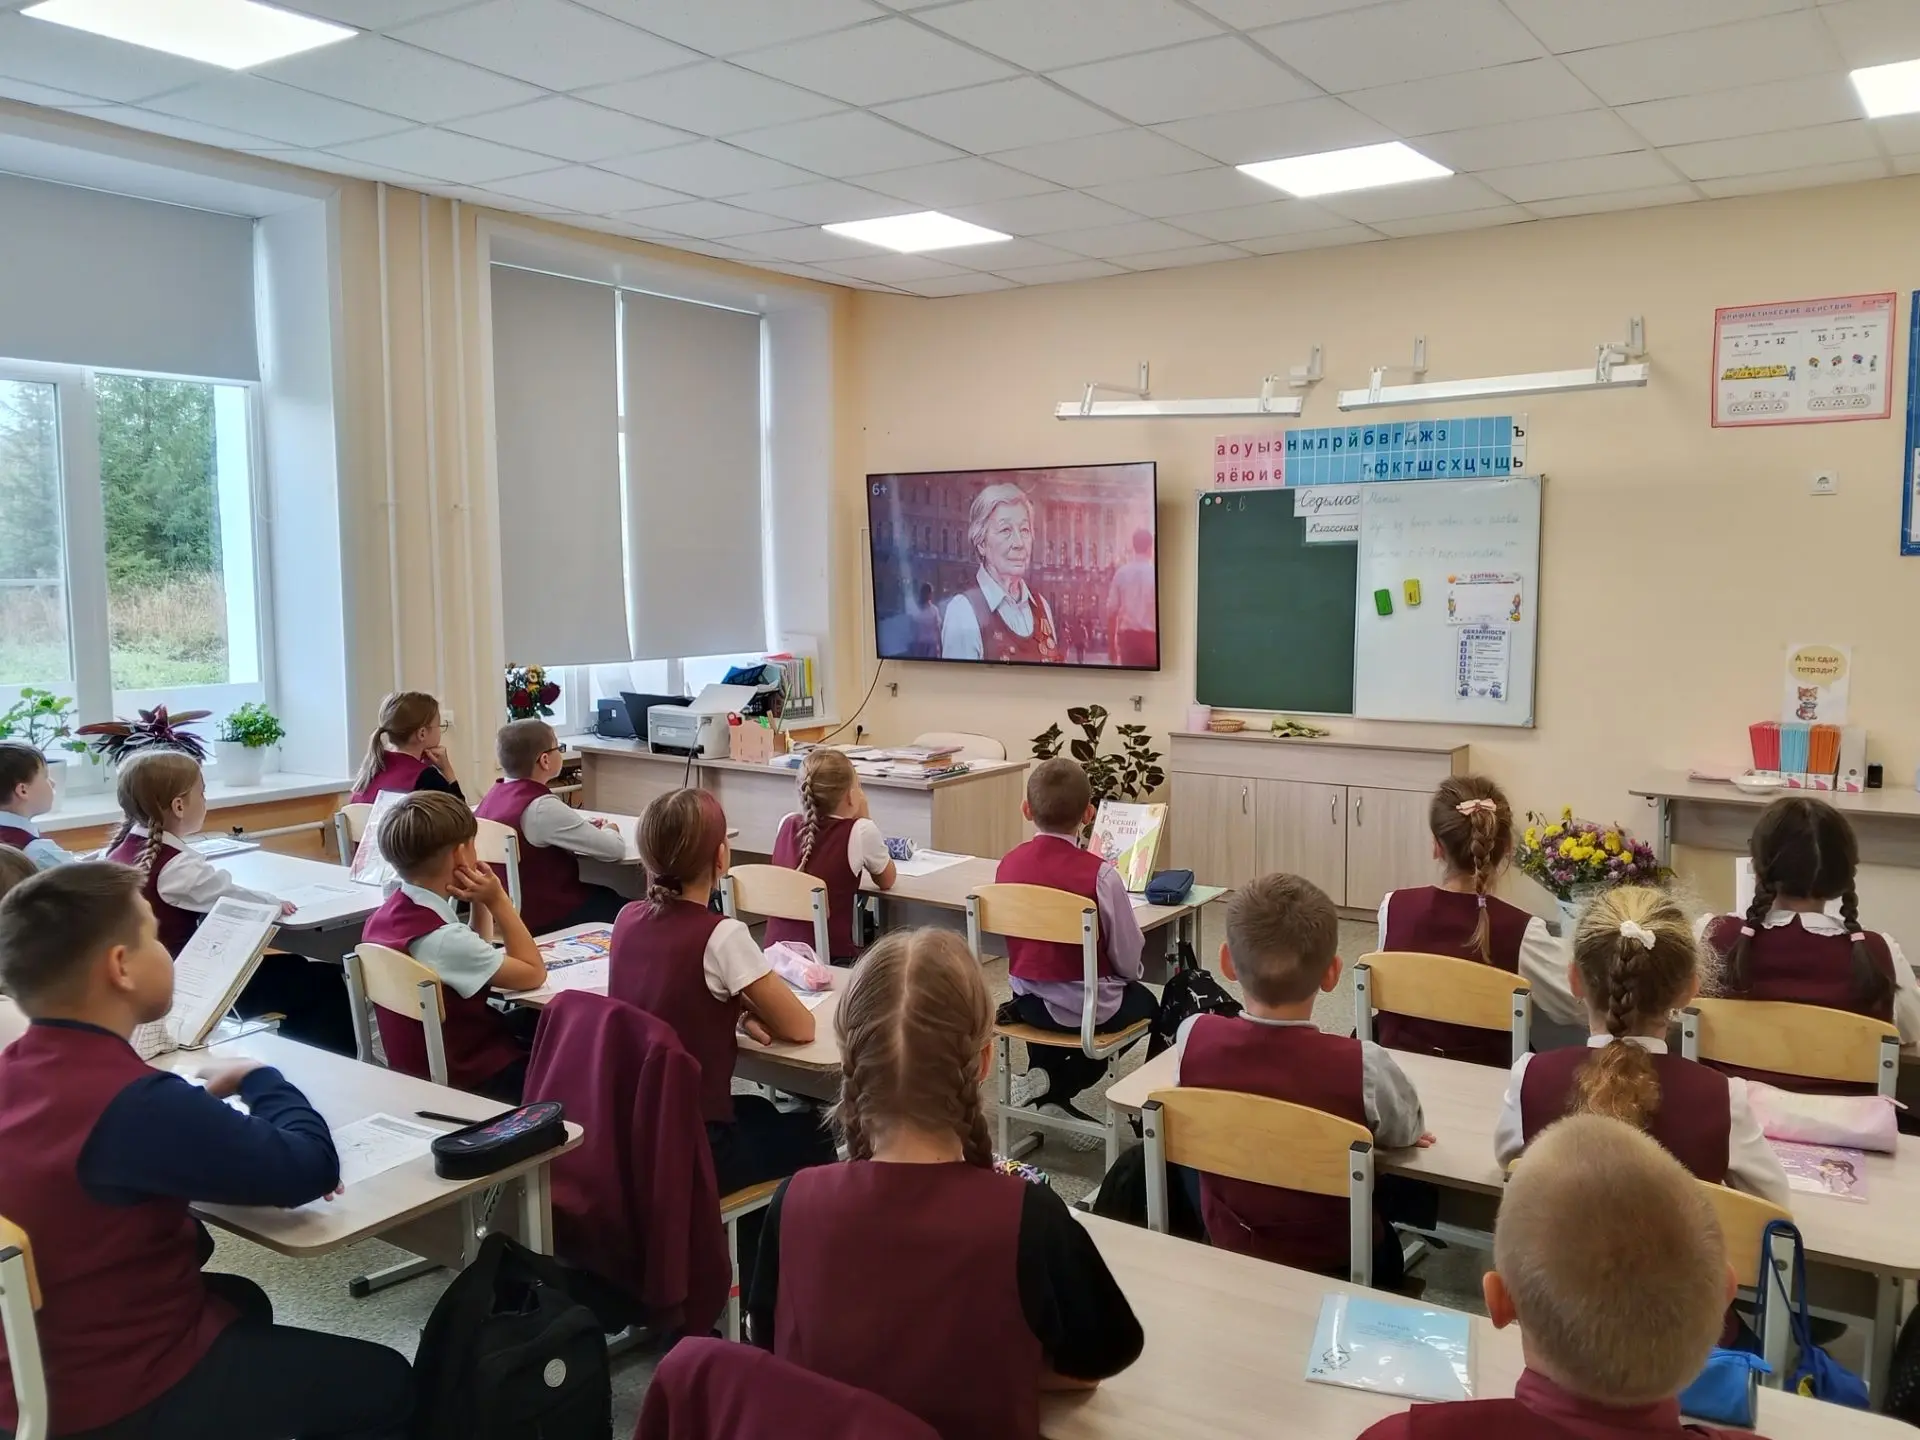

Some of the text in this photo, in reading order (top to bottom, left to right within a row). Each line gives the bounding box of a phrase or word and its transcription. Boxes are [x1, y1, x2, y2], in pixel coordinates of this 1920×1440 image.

[1776, 337, 1786, 345] 12
[1817, 334, 1827, 342] 15
[872, 483, 888, 496] 6+
[1300, 489, 1360, 513] Седьмое
[1309, 522, 1359, 534] Классная
[1817, 656, 1839, 664] сдал
[1797, 666, 1839, 675] тетради?
